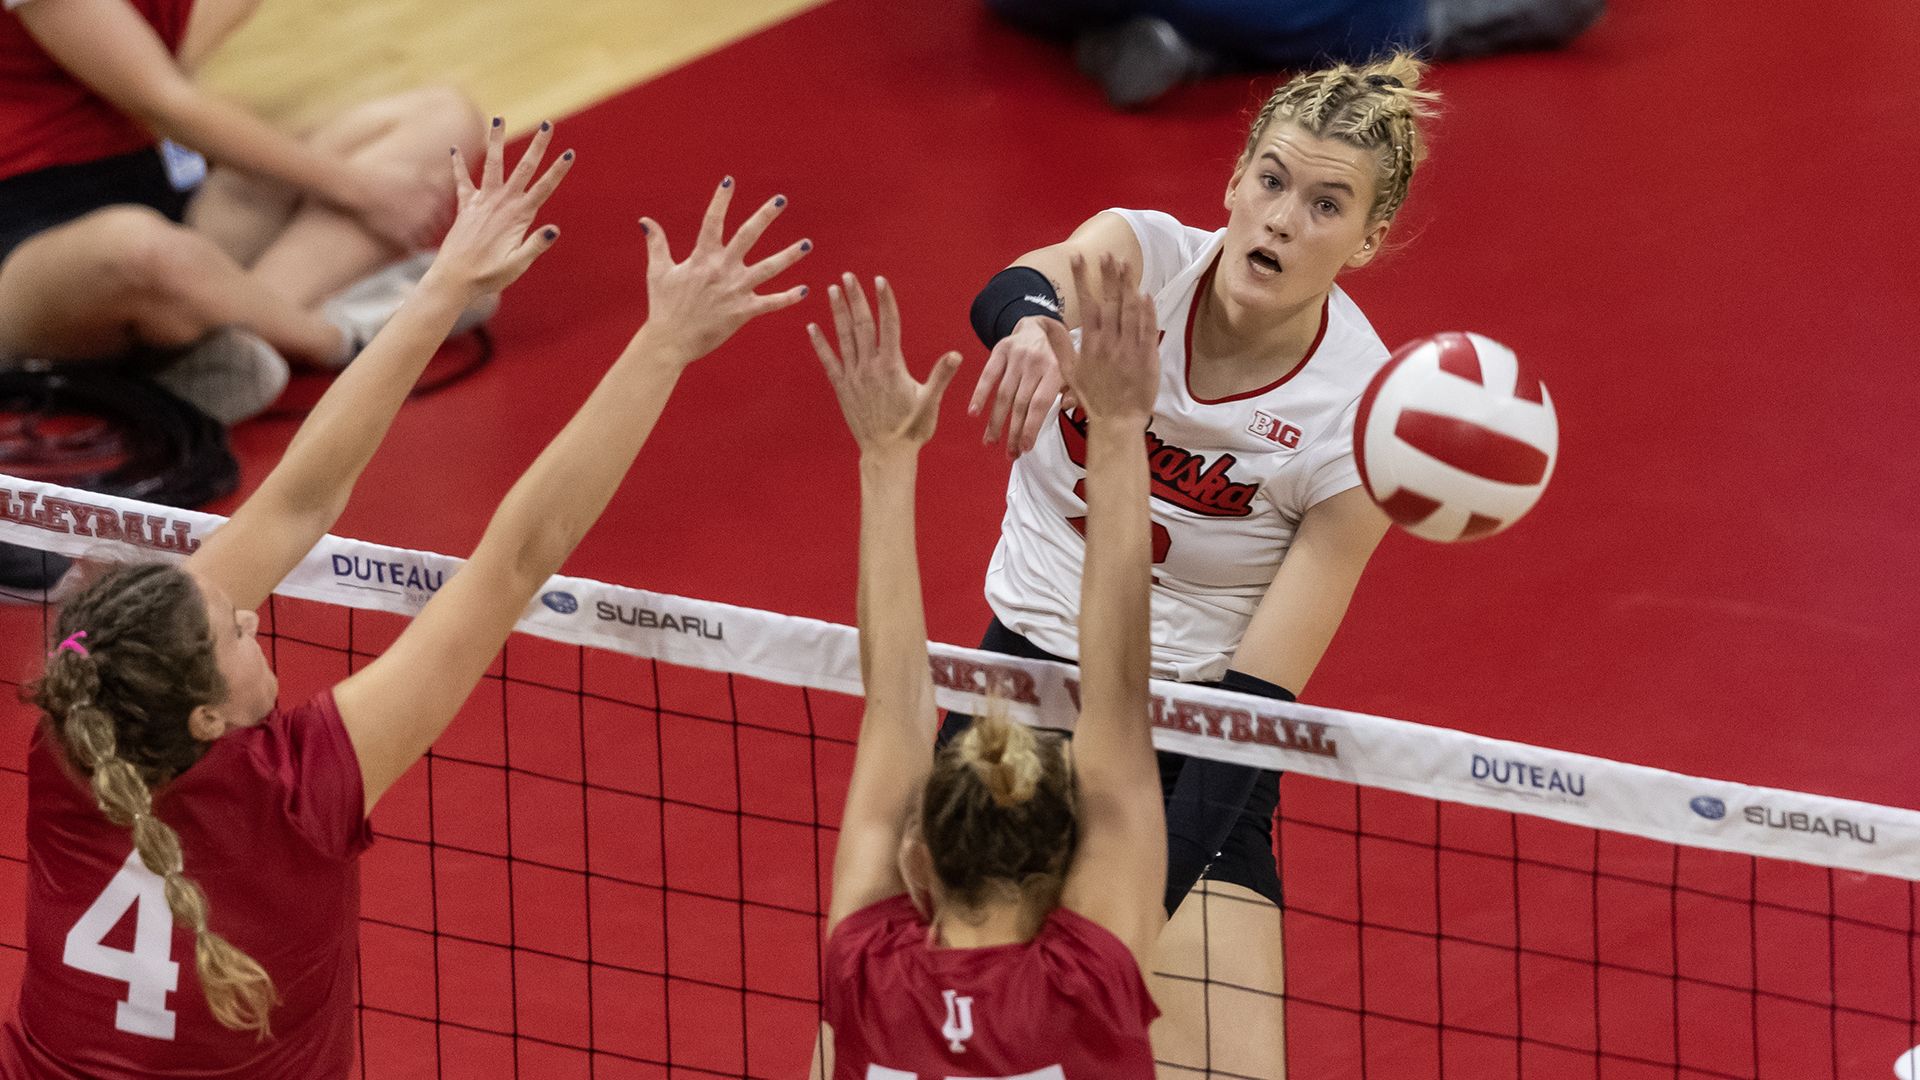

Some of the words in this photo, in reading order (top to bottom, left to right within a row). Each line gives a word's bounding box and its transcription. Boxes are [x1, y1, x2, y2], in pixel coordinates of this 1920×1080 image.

[332, 554, 443, 592] DUTEAU
[596, 600, 723, 640] SUBARU
[1471, 754, 1585, 797] DUTEAU
[1743, 805, 1875, 844] SUBARU
[62, 847, 179, 1040] 4
